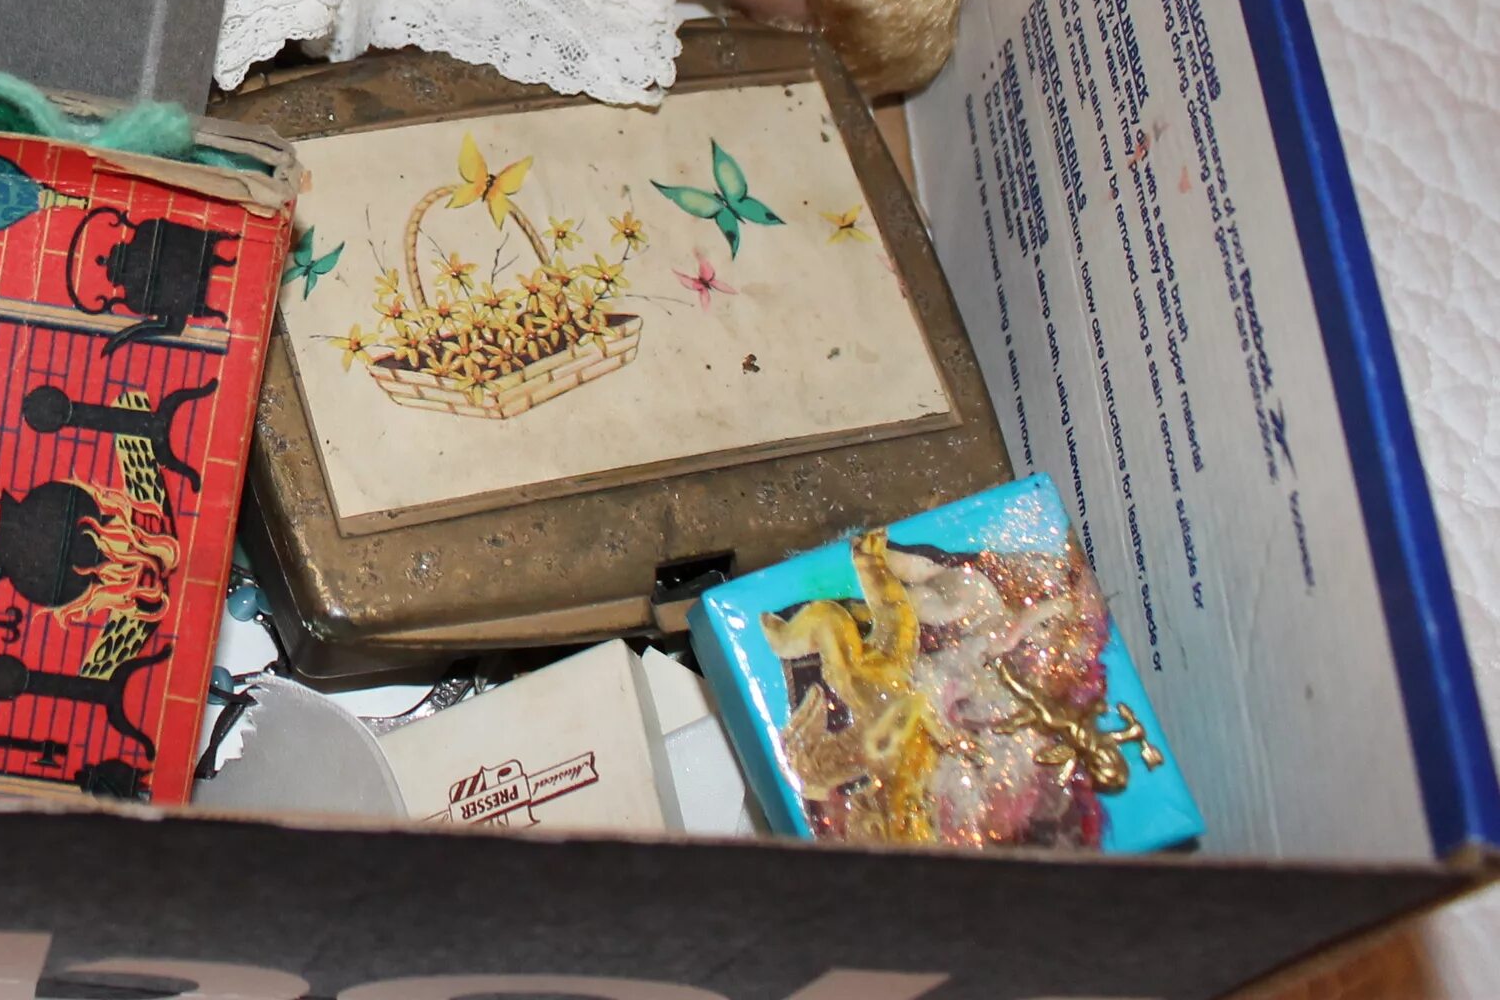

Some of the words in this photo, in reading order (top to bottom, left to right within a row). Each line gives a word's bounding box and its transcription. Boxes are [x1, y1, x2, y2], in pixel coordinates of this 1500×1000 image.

[1064, 18, 1072, 40] or
[1096, 7, 1108, 43] use
[1103, 43, 1121, 103] water;
[1121, 12, 1150, 108] NUBUCK
[1167, 29, 1192, 100] drying,
[1184, 37, 1200, 79] and
[1046, 92, 1056, 119] on
[1116, 100, 1125, 116] it
[1018, 114, 1032, 160] AND
[1051, 118, 1071, 191] material
[1056, 95, 1087, 213] MATERIALS
[1118, 116, 1134, 158] may
[1111, 20, 1129, 77] brush
[1122, 76, 1140, 128] away
[1135, 126, 1148, 161] dirt
[1142, 161, 1158, 203] with
[1169, 283, 1190, 343] brush
[1065, 190, 1085, 261] texture,
[1072, 13, 1093, 79] grease
[1087, 75, 1105, 132] stains
[1097, 131, 1114, 175] may
[1108, 173, 1120, 200] be
[1114, 200, 1139, 284] removed
[1130, 285, 1150, 341] using
[1147, 360, 1165, 408] stain
[1127, 158, 1161, 277] permanently
[1079, 260, 1097, 314] follow
[1155, 278, 1172, 326] stain
[1091, 317, 1105, 360] care
[1163, 328, 1185, 387] upper
[1035, 267, 1051, 320] damp
[1045, 321, 1061, 372] cloth,
[1053, 374, 1071, 425] using
[1064, 426, 1089, 516] lukewarm
[1099, 362, 1128, 470] instructions
[1120, 473, 1134, 499] for
[1123, 504, 1149, 580] leather,
[1138, 583, 1160, 646] suede
[1151, 651, 1163, 672] or
[460, 784, 520, 820] PRESSER
[532, 760, 591, 796] Musical
